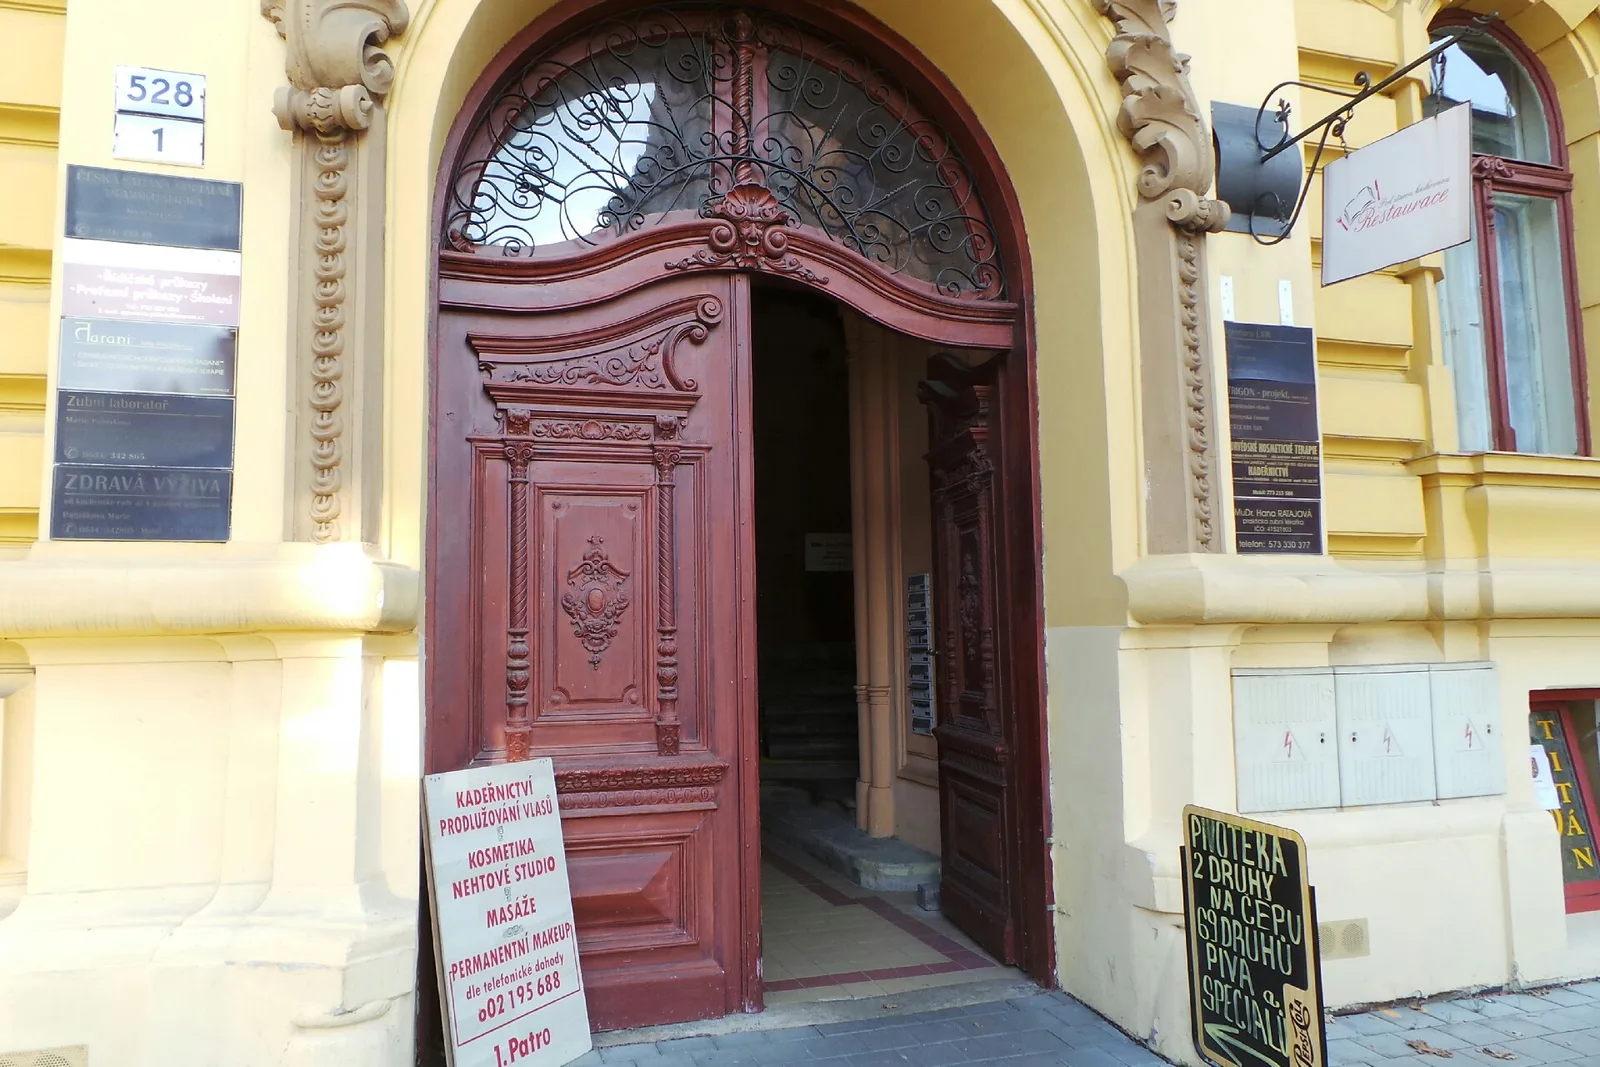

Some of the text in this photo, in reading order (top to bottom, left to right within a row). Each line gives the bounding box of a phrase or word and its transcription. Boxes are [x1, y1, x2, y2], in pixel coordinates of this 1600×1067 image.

[127, 75, 193, 107] 528
[152, 127, 164, 152] 1
[1352, 188, 1449, 232] Restaurace
[64, 472, 220, 493] ZDRAVÁ VÝŽIVA
[1277, 508, 1313, 518] RATAJOVÁ
[1268, 540, 1282, 549] 573
[1283, 540, 1296, 549] 330
[1297, 541, 1311, 549] 377
[456, 775, 534, 808] KADEŘNICTVÍ
[1537, 720, 1594, 869] TITÁN
[440, 794, 553, 837] PRODLUŽOVÁNÍ VLASŮ
[468, 837, 535, 870] KOSMETIKA
[452, 856, 556, 899] NEHTOVÉ STUDIO
[1193, 852, 1274, 901] 2 DRUHY
[487, 894, 536, 928] MASÁŽE
[1210, 885, 1300, 945] NA ČEPU
[451, 922, 571, 981] PERMANENTNÍ MAKEUP
[1220, 915, 1292, 975] DRUHŮ
[466, 951, 564, 1000] dle telefonické dohody
[508, 981, 534, 1009] 195
[537, 970, 561, 997] 688
[1206, 942, 1255, 996] PIVA
